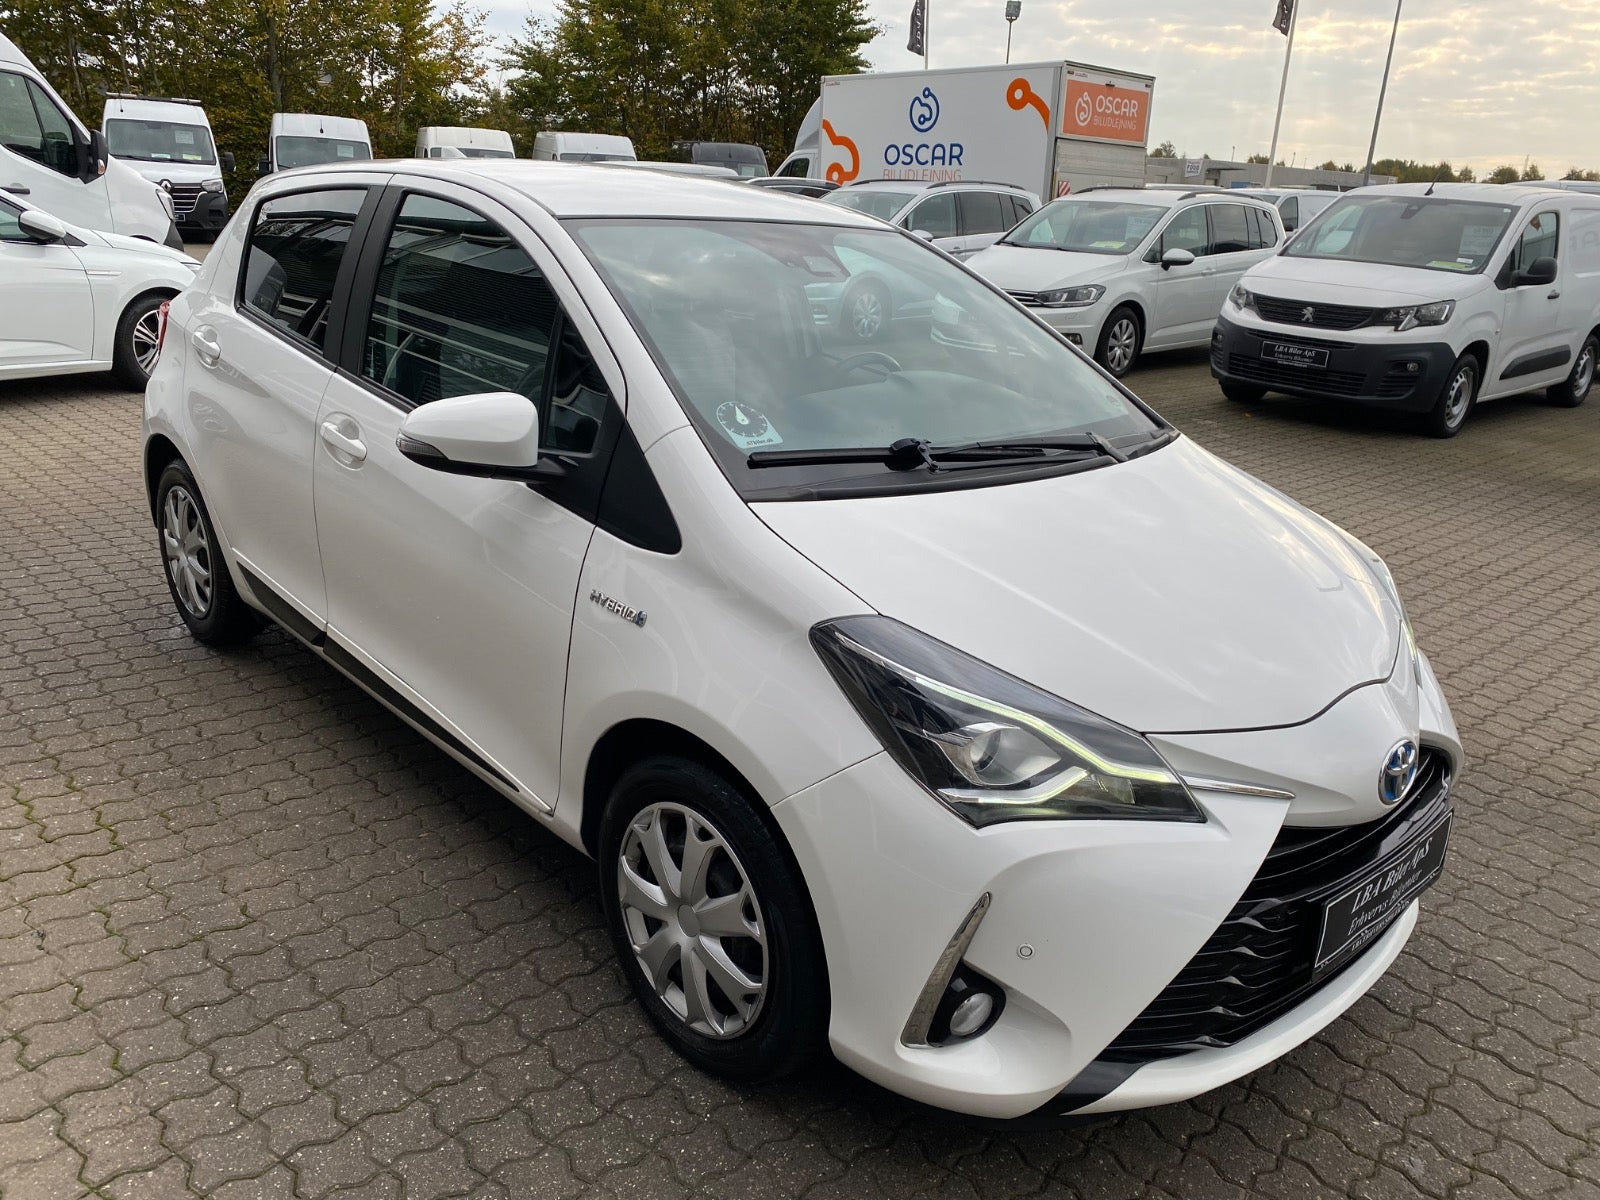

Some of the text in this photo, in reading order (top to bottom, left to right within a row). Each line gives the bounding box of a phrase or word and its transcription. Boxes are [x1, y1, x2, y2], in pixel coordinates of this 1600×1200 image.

[1095, 95, 1138, 118] OSCAR
[1093, 115, 1137, 130] BILUDLEJNING
[883, 143, 964, 166] OSCAR
[590, 589, 637, 623] HYBRID
[1351, 837, 1433, 914] LBA Biler ApS
[1347, 899, 1389, 936] Erhvervs
